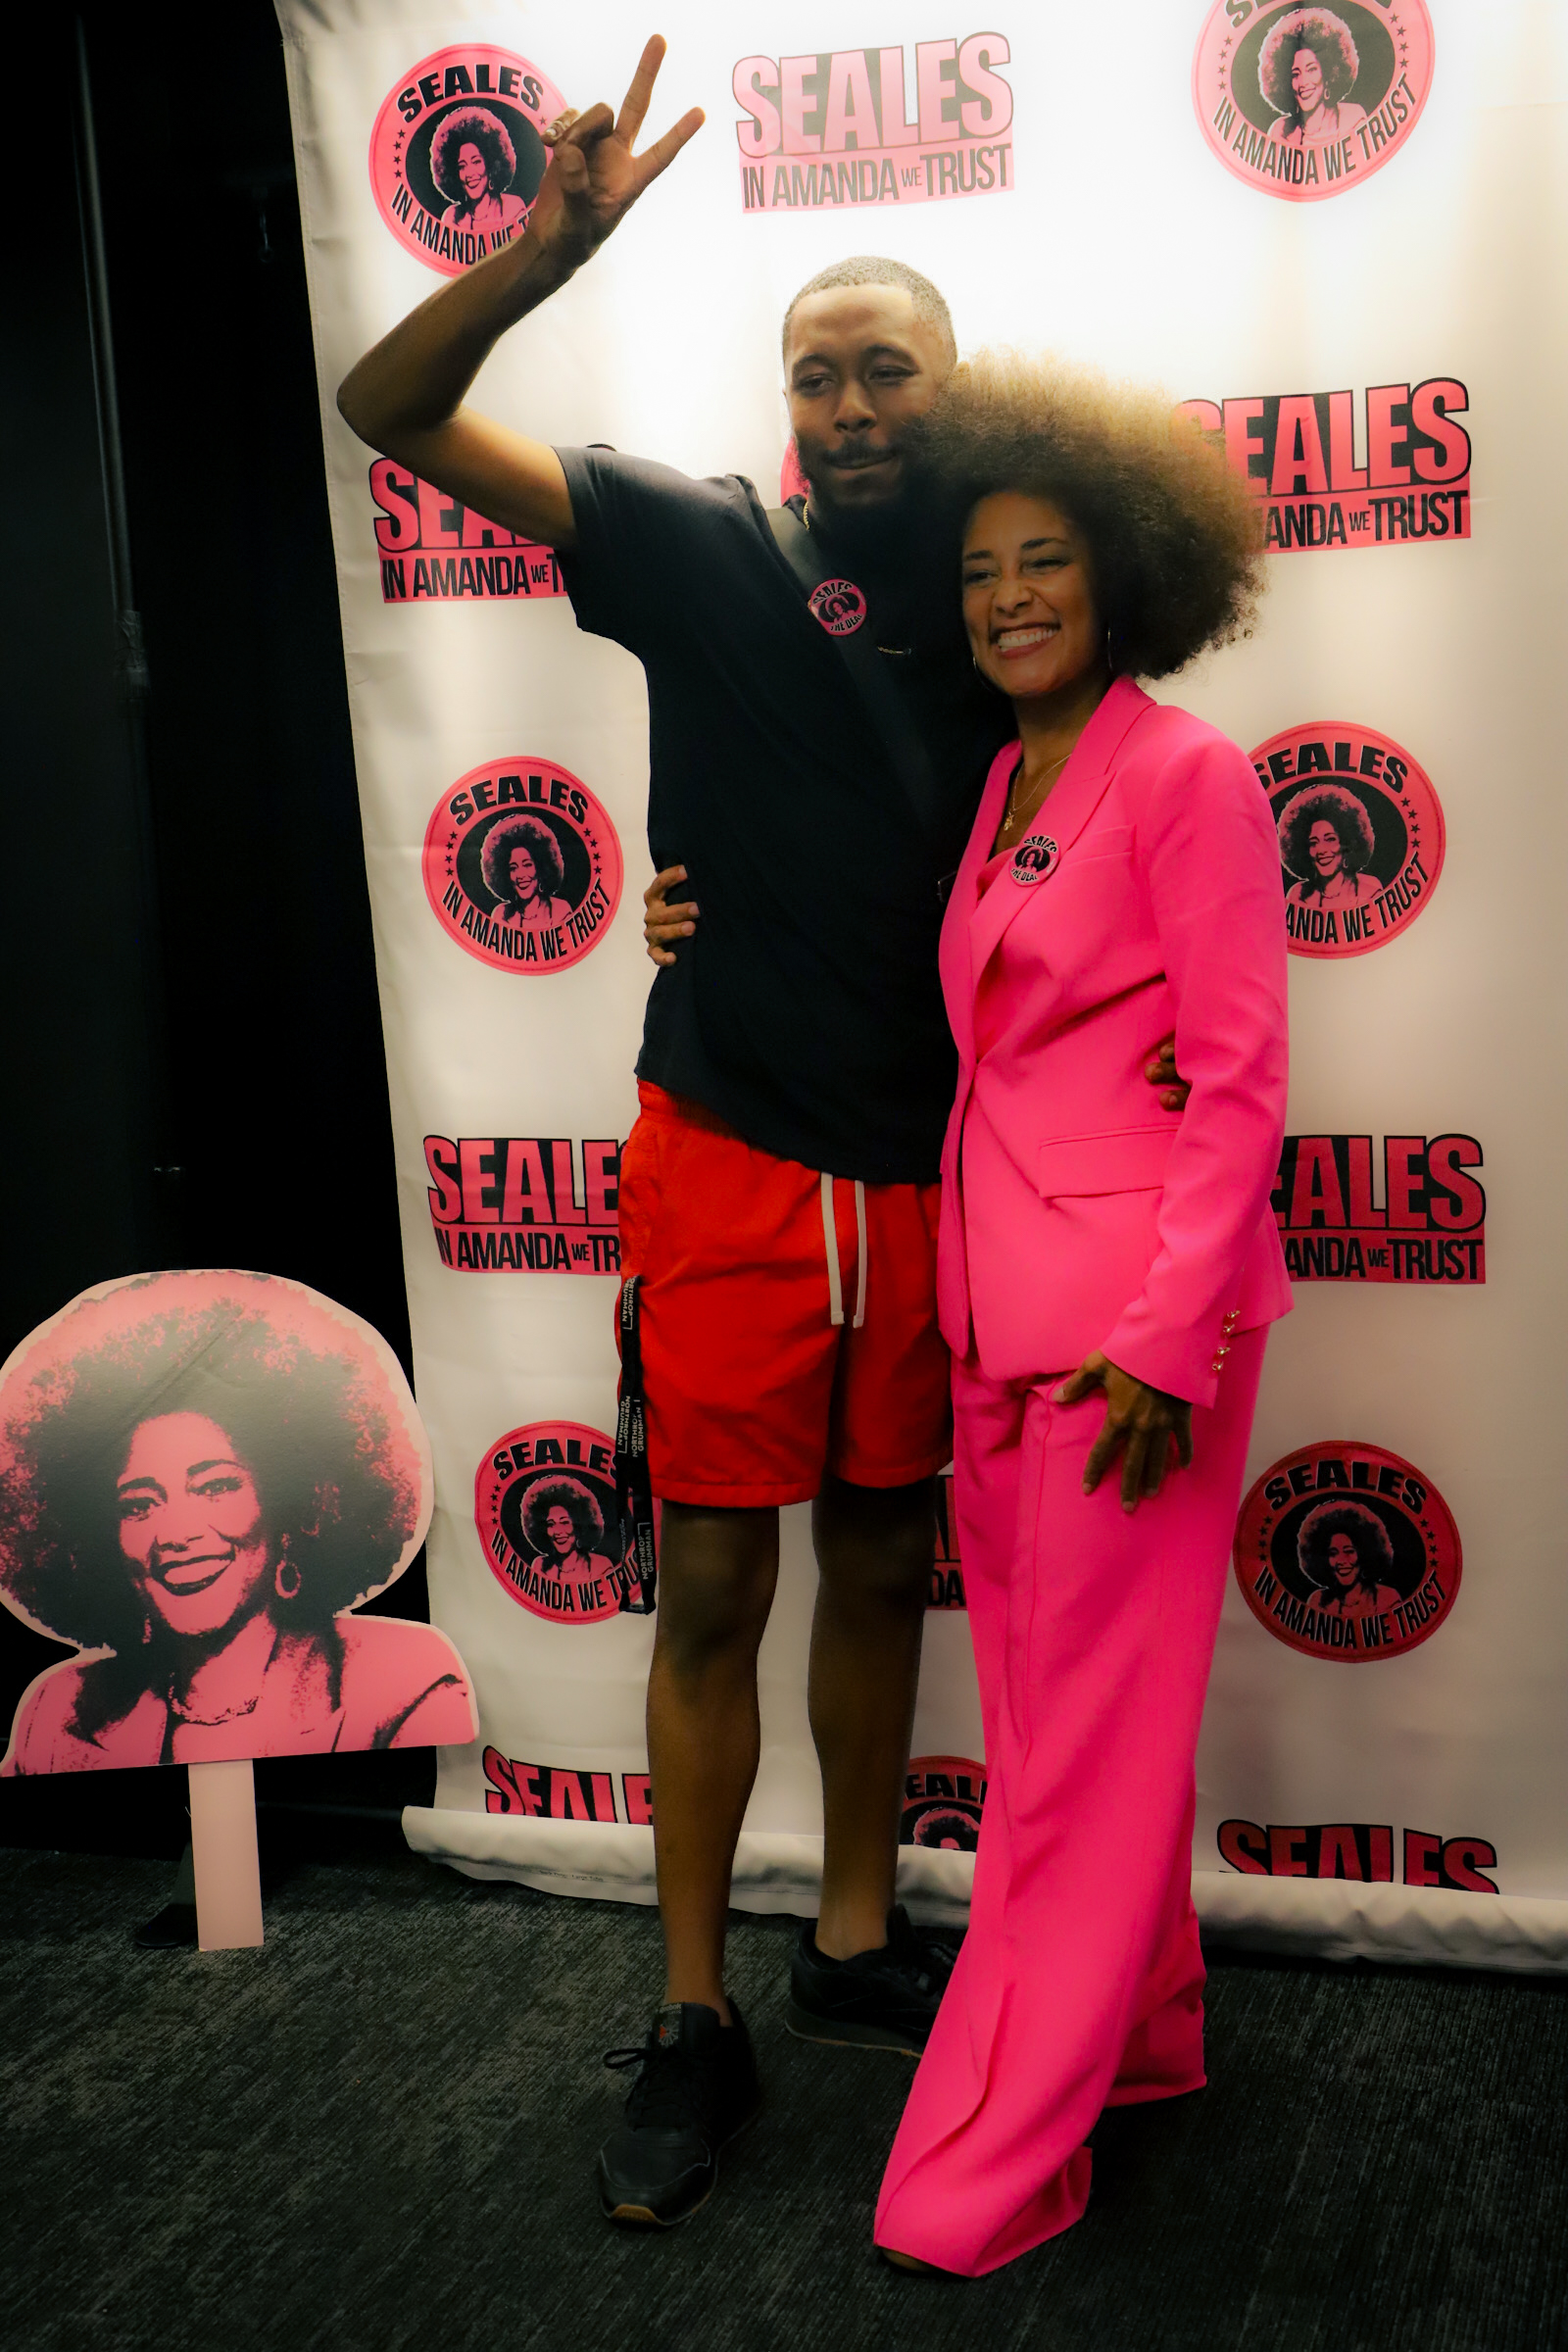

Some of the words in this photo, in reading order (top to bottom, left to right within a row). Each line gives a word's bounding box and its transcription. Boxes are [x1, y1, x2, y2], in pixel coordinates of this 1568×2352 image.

[397, 64, 544, 123] SEALES
[732, 31, 1013, 159] SEALES
[1213, 96, 1235, 142] IN
[1231, 122, 1319, 185] AMANDA
[1323, 135, 1356, 182] WE
[1356, 73, 1416, 162] TRUST
[742, 166, 765, 209] IN
[771, 158, 900, 207] AMANDA
[901, 166, 922, 187] WE
[919, 143, 1011, 196] TRUST
[391, 182, 412, 224] IN
[410, 220, 487, 266] AMANDA
[1264, 502, 1348, 549] ANDA
[1348, 511, 1370, 532] WE
[1368, 490, 1469, 542] TRUST
[382, 559, 407, 599] IN
[413, 555, 531, 598] AMANDA
[531, 564, 549, 584] WE
[449, 775, 589, 826] SEALES
[442, 880, 464, 919] IN
[461, 904, 538, 961] AMANDA
[540, 926, 567, 961] WE
[565, 877, 611, 950] TRUST
[1286, 903, 1339, 944] ANDA
[1342, 904, 1375, 943] WE
[1374, 851, 1429, 929] TRUST
[423, 1135, 628, 1227] SEALE
[1270, 1134, 1487, 1233] ALES
[434, 1226, 453, 1266] IN
[458, 1232, 571, 1270] AMANDA
[571, 1243, 590, 1261] WE
[1285, 1237, 1366, 1278] ANDA
[1367, 1249, 1389, 1268] WE
[1387, 1239, 1484, 1280] TRUST
[627, 1277, 636, 1316] ORTHROP
[493, 1439, 616, 1480] SEALE
[1264, 1459, 1427, 1515] SEALES
[491, 1528, 509, 1564] IN
[505, 1553, 575, 1612] AMANDA
[578, 1579, 607, 1612] WE
[638, 1536, 649, 1580] NORTHROP
[645, 1529, 654, 1573] GRUMMAN
[1253, 1565, 1277, 1606] IN
[1272, 1590, 1357, 1649] AMANDA
[1360, 1613, 1394, 1648] WE
[1393, 1570, 1446, 1639] TRUST
[482, 1745, 654, 1826] SEALE
[905, 1773, 988, 1805] EAL
